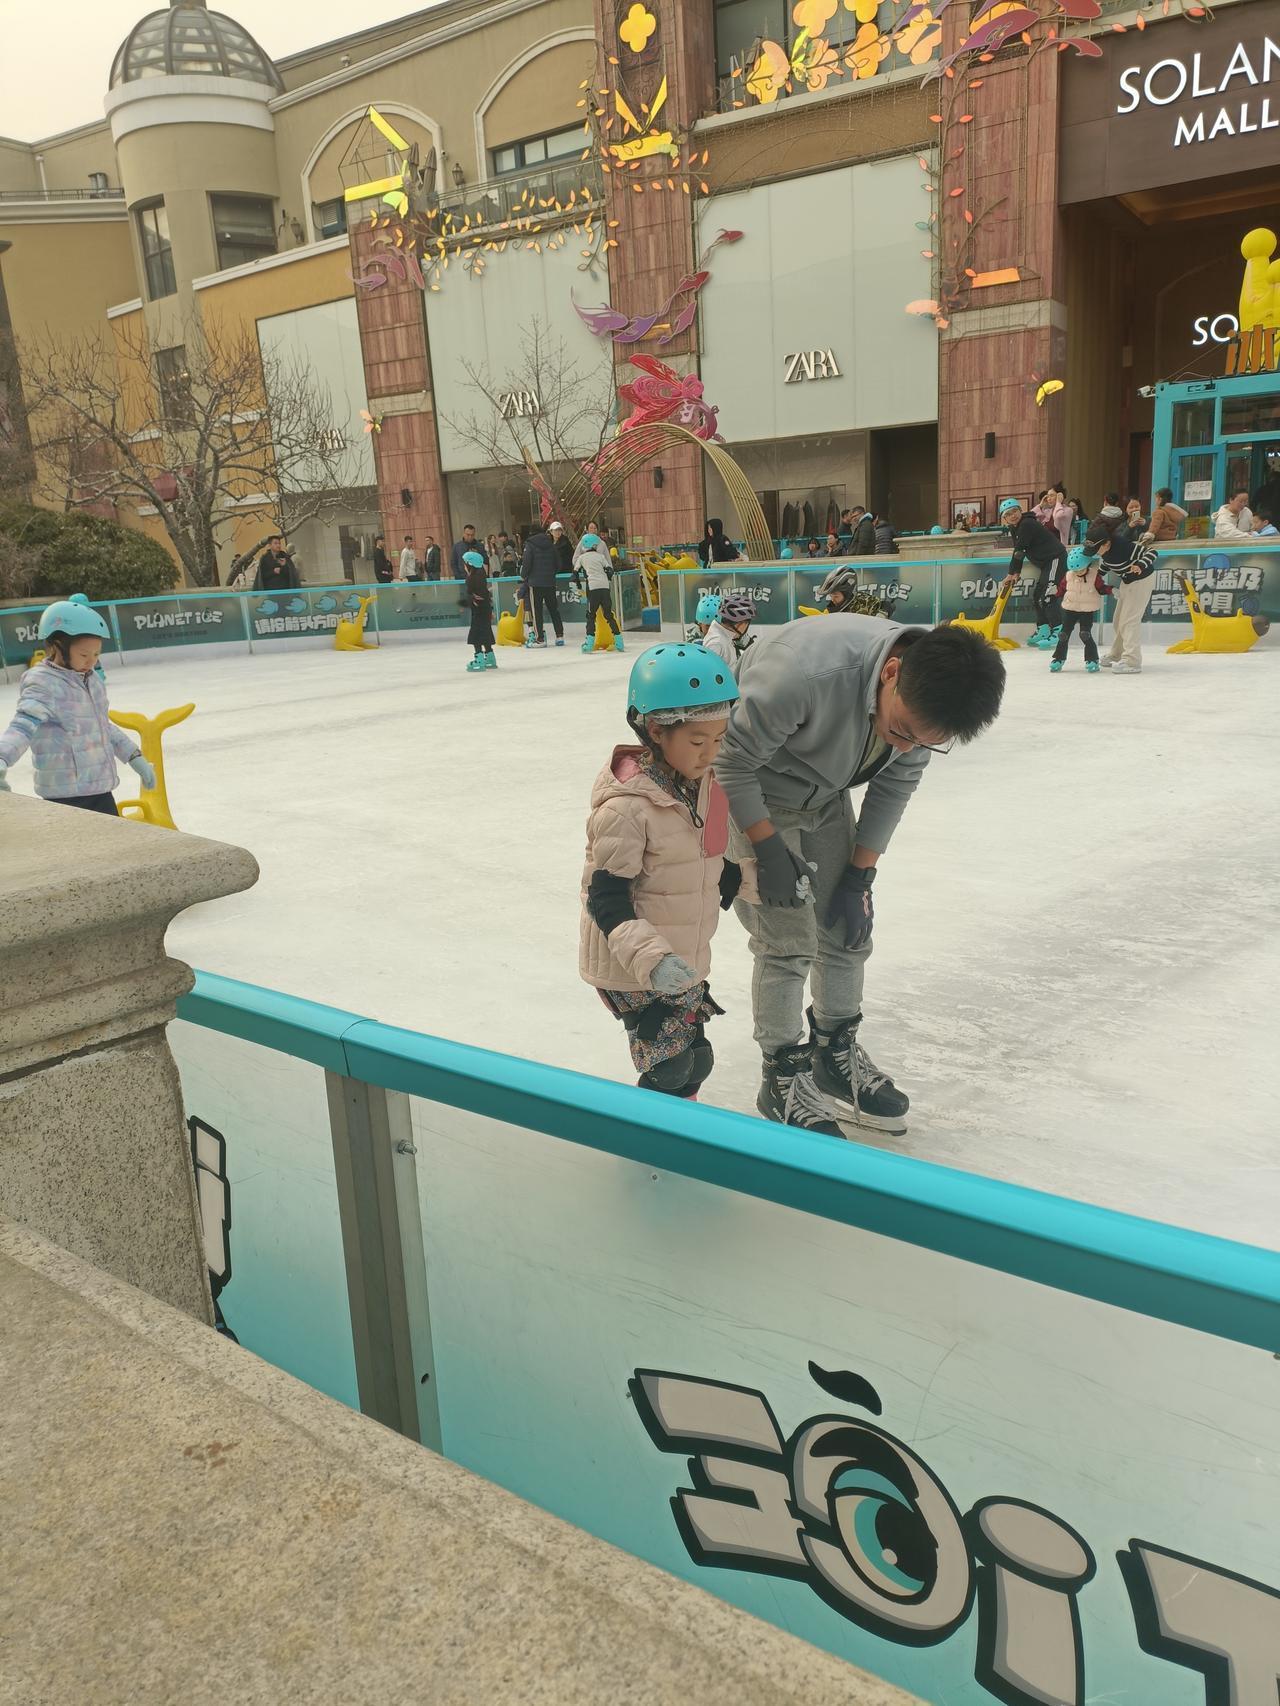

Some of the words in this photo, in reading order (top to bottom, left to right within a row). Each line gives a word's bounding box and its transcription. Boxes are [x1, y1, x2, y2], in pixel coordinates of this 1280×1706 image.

[1173, 98, 1280, 146] MALL
[783, 348, 843, 384] ZARA
[498, 389, 542, 420] ZARA
[960, 577, 1034, 599] PLAET
[133, 611, 193, 630] PLANET
